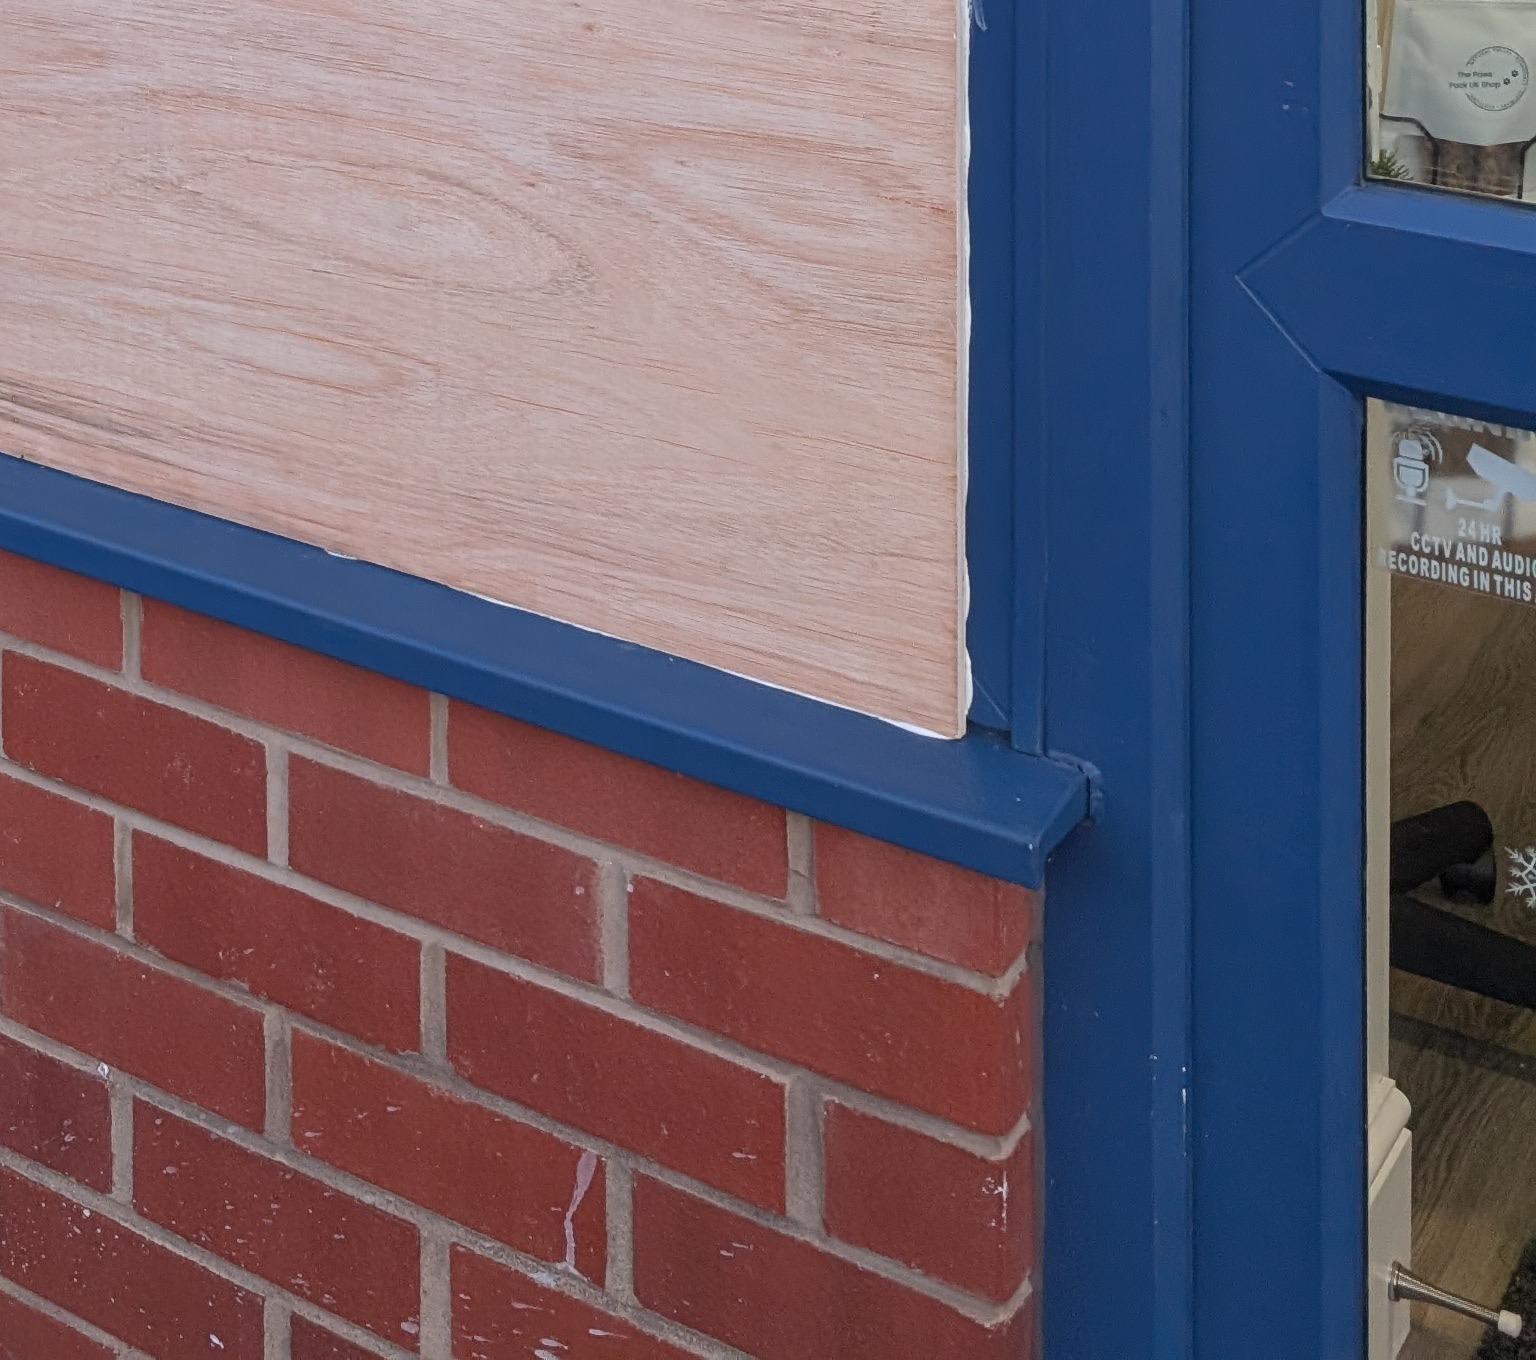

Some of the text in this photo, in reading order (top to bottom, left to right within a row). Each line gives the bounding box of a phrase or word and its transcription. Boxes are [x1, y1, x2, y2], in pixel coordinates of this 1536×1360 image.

[1410, 531, 1452, 559] CCTV
[1455, 542, 1489, 567] AND
[1457, 518, 1503, 546] 24 HR
[1377, 545, 1532, 603] RECORDING IN THIS
